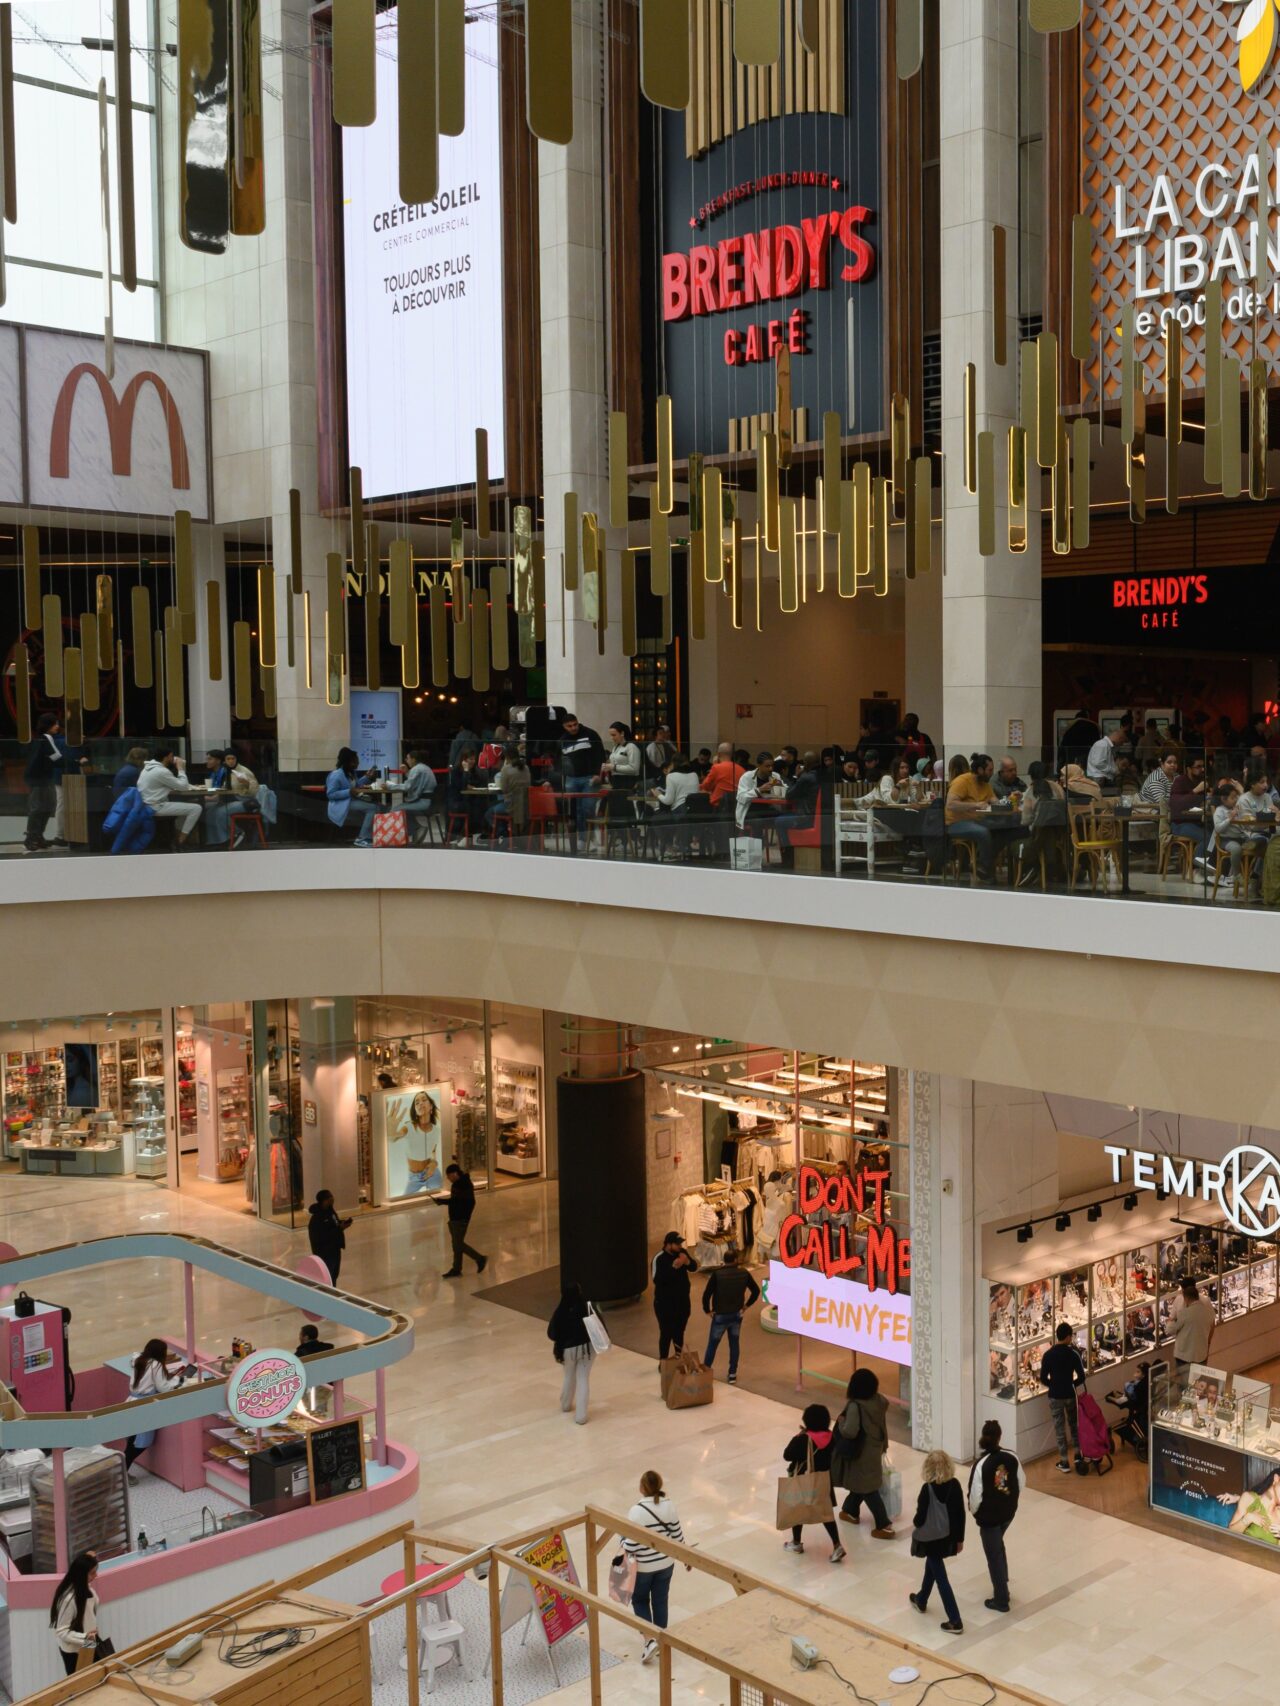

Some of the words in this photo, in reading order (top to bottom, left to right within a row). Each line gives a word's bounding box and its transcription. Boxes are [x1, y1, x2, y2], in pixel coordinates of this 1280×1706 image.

[373, 203, 428, 233] CRÉTEIL
[431, 182, 481, 215] SOLEIL
[1114, 174, 1183, 239] LA
[382, 232, 413, 251] CENTRE
[415, 215, 470, 241] COMMERCIAL
[383, 262, 441, 294] TOUJOURS
[443, 253, 472, 278] PLUS
[663, 205, 873, 322] BRENDY'S
[402, 279, 467, 313] DÉCOUVRIR
[1160, 294, 1207, 339] goû
[1227, 286, 1262, 320] de
[723, 307, 808, 366] CAFÉ
[1113, 575, 1208, 607] BRENDY'S
[1141, 609, 1179, 629] CAFÉ
[800, 1165, 892, 1225] DON'T
[779, 1213, 864, 1280] CALL
[867, 1224, 912, 1295] ME
[237, 1375, 302, 1414] DONUTS
[1162, 1448, 1172, 1456] FAIT
[1172, 1451, 1185, 1460] POUR
[1186, 1455, 1200, 1464] CETTE
[1194, 1465, 1209, 1474] JUSTE
[1185, 1489, 1203, 1500] FOSSIL
